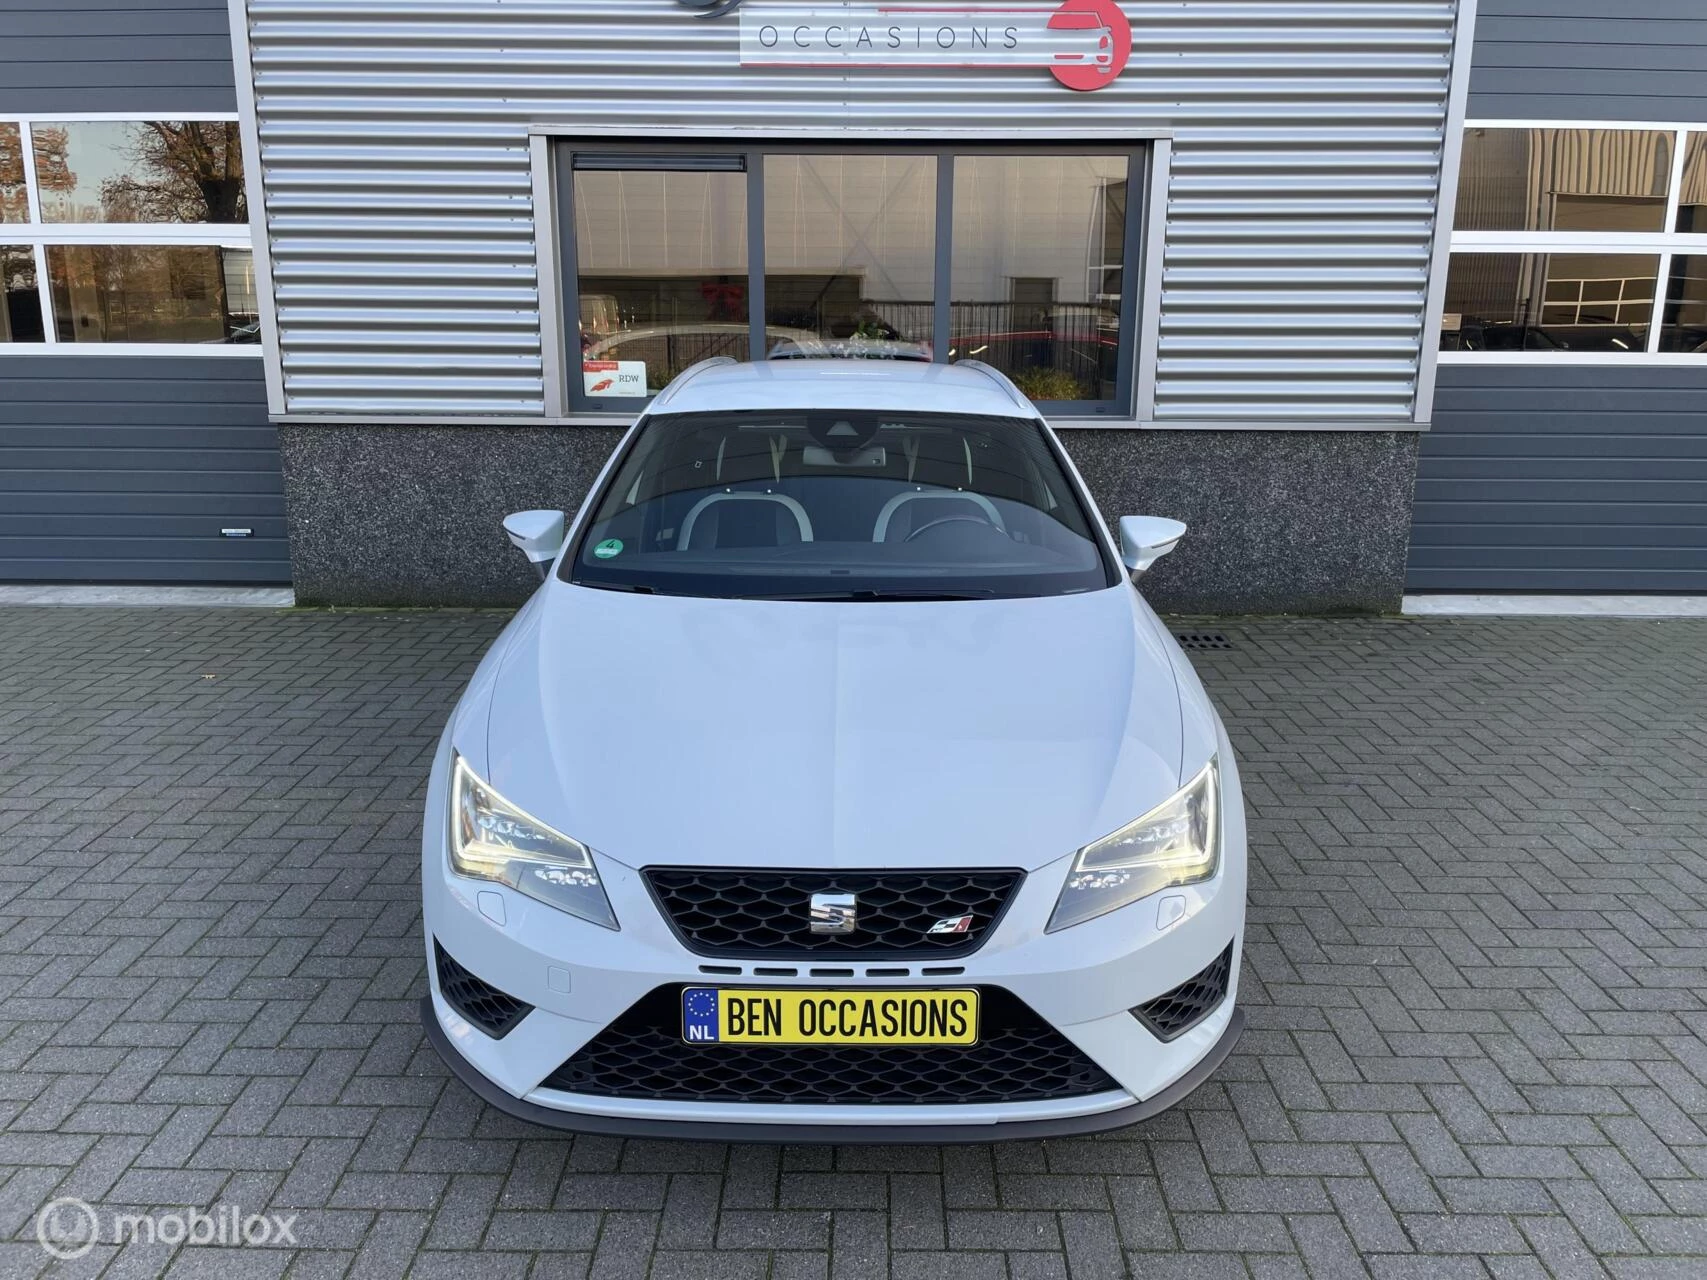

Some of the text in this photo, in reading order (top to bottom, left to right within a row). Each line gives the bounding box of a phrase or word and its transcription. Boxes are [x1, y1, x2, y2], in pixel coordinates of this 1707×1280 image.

[758, 25, 1018, 48] OCCASIONS
[619, 374, 639, 382] RDW
[606, 540, 616, 549] 4
[727, 997, 968, 1037] BEN OCCASIONS
[689, 1025, 714, 1040] NL
